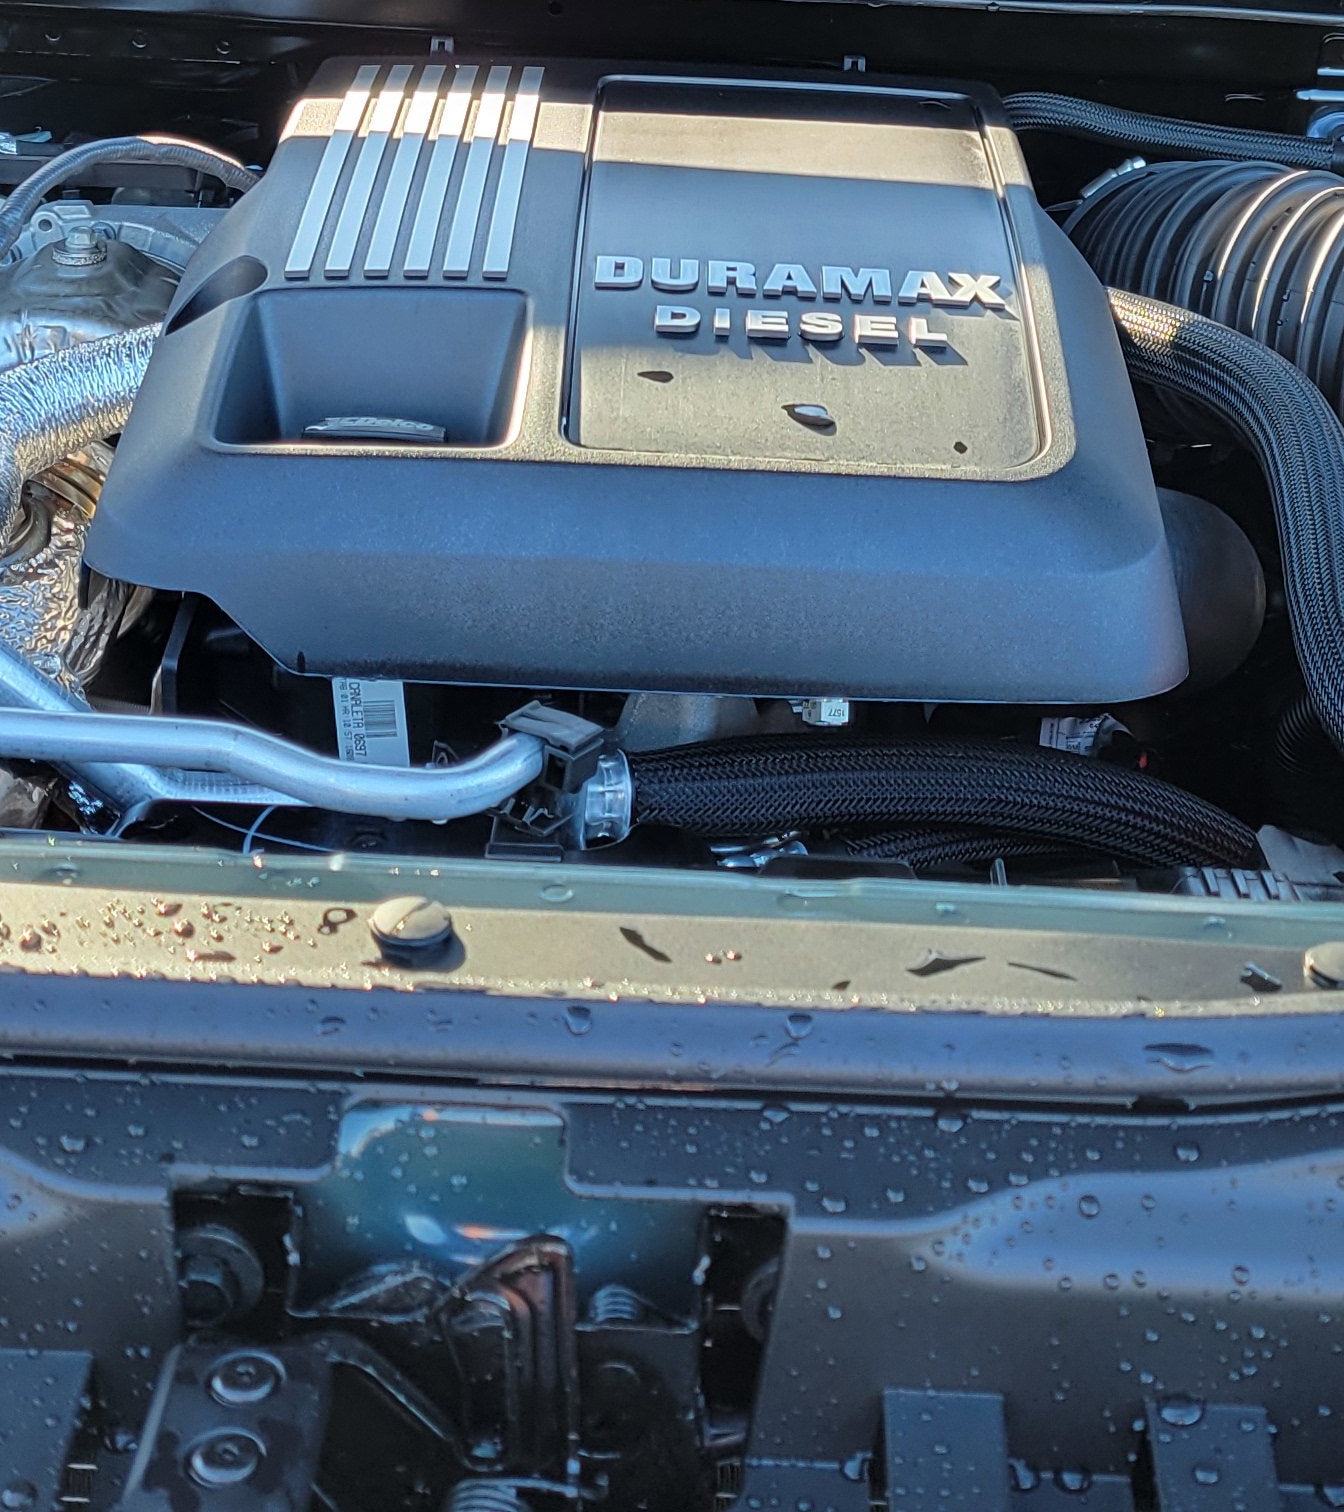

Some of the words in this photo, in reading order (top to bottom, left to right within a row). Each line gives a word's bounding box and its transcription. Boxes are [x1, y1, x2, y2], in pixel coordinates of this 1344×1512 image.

[594, 254, 1007, 310] DURAMAX
[654, 304, 948, 348] DIESEL
[353, 733, 367, 757] 0697
